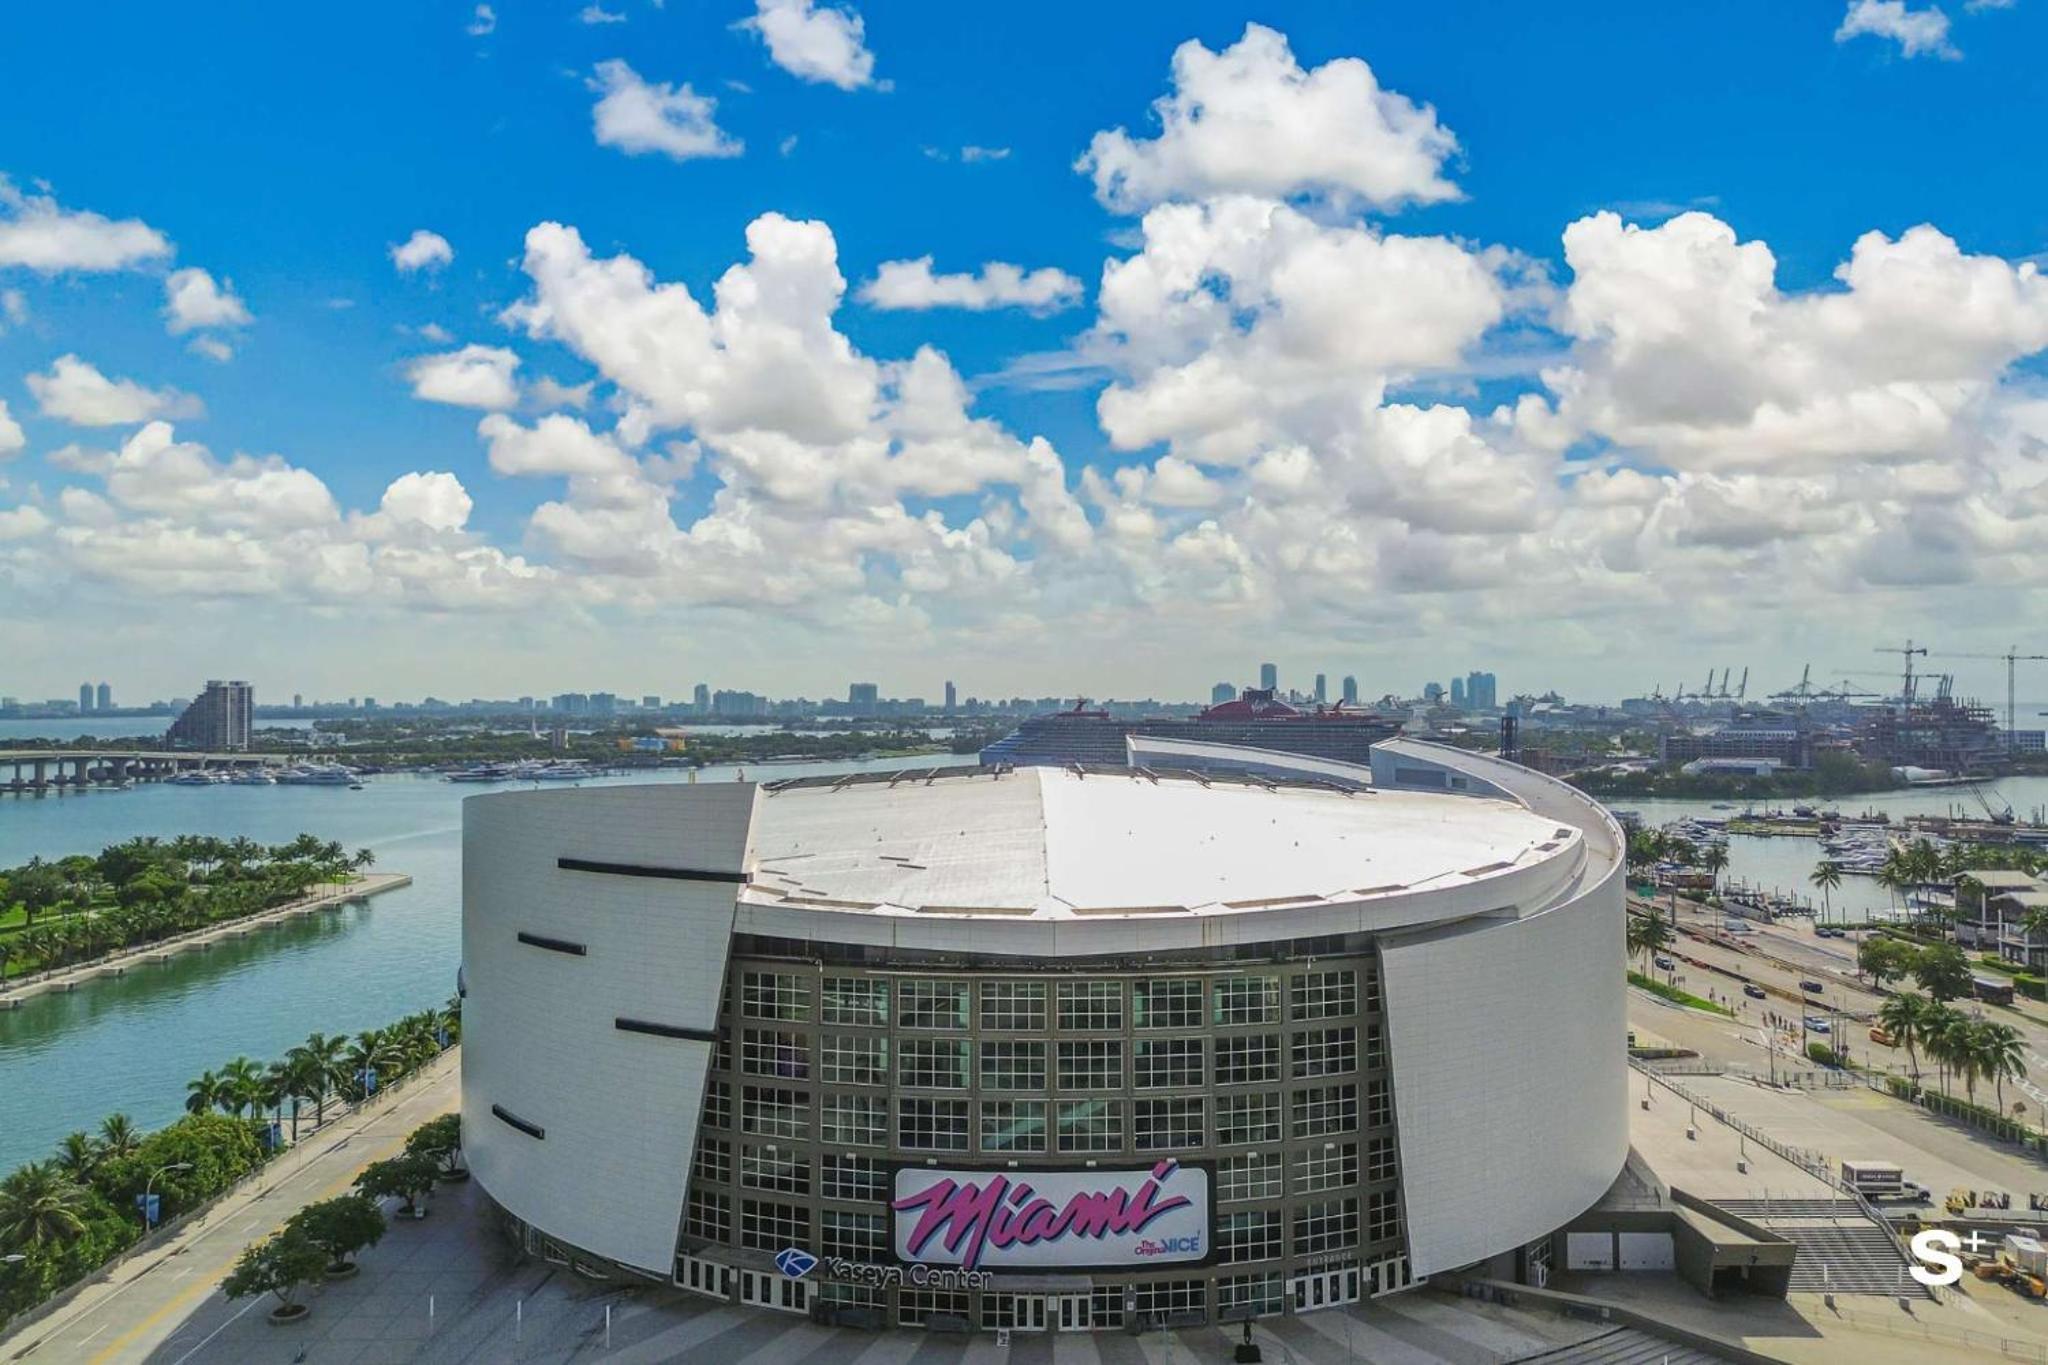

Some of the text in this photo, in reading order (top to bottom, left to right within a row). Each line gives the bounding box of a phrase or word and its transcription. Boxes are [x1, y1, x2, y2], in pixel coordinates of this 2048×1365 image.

[891, 1159, 1191, 1270] Miami
[824, 1256, 993, 1291] Kaseya Center
